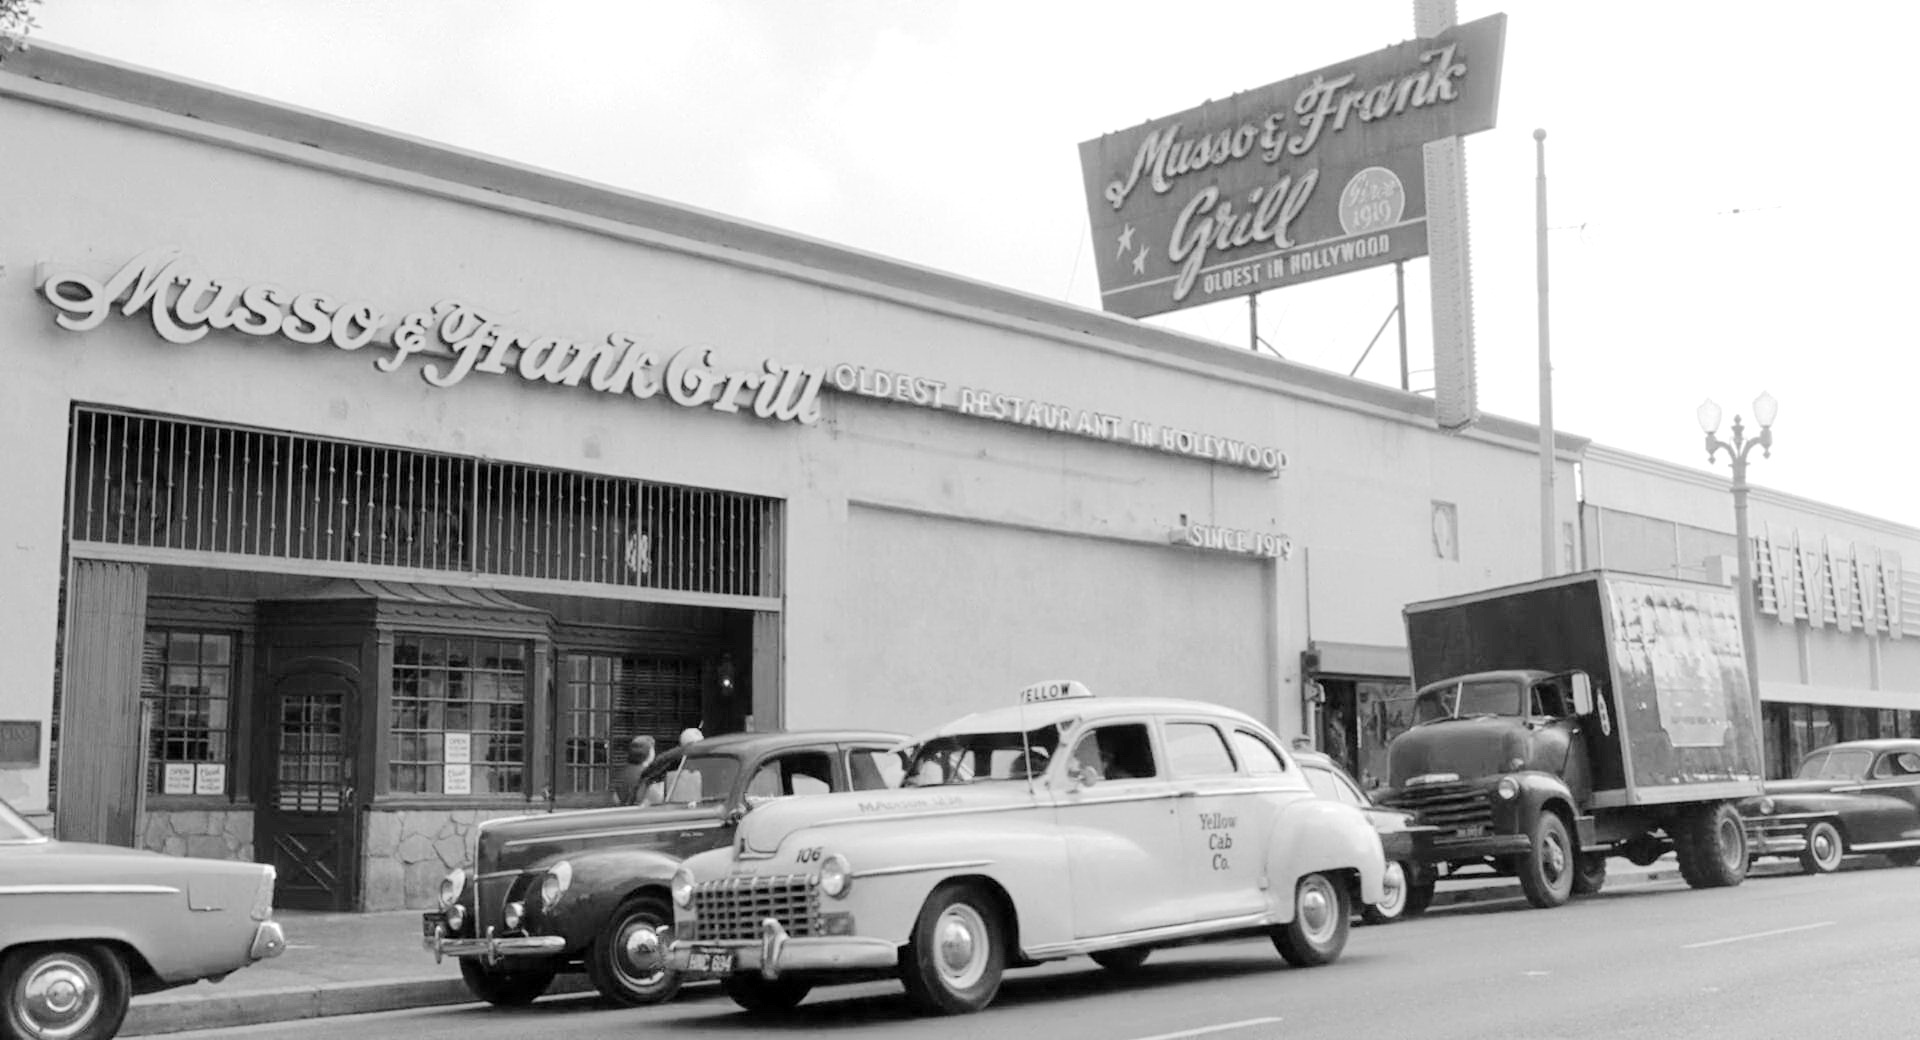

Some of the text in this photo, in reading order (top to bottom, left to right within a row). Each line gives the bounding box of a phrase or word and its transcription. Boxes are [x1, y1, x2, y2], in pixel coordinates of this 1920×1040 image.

[1105, 42, 1467, 209] Musso & Frank
[1353, 200, 1392, 230] 1919
[1168, 168, 1320, 300] Grill
[1203, 263, 1262, 294] OLDEST
[1289, 234, 1391, 275] HOLLYWOOD
[44, 245, 827, 424] Musso & Frank Grill
[834, 362, 1290, 470] OLDEST RESTAURANT IN HOLLYWOOD
[1190, 525, 1294, 560] SINCE 1919
[1199, 812, 1239, 830] Yellow
[795, 846, 824, 864] 106
[1209, 833, 1233, 850] Cab
[1212, 853, 1231, 870] Co.
